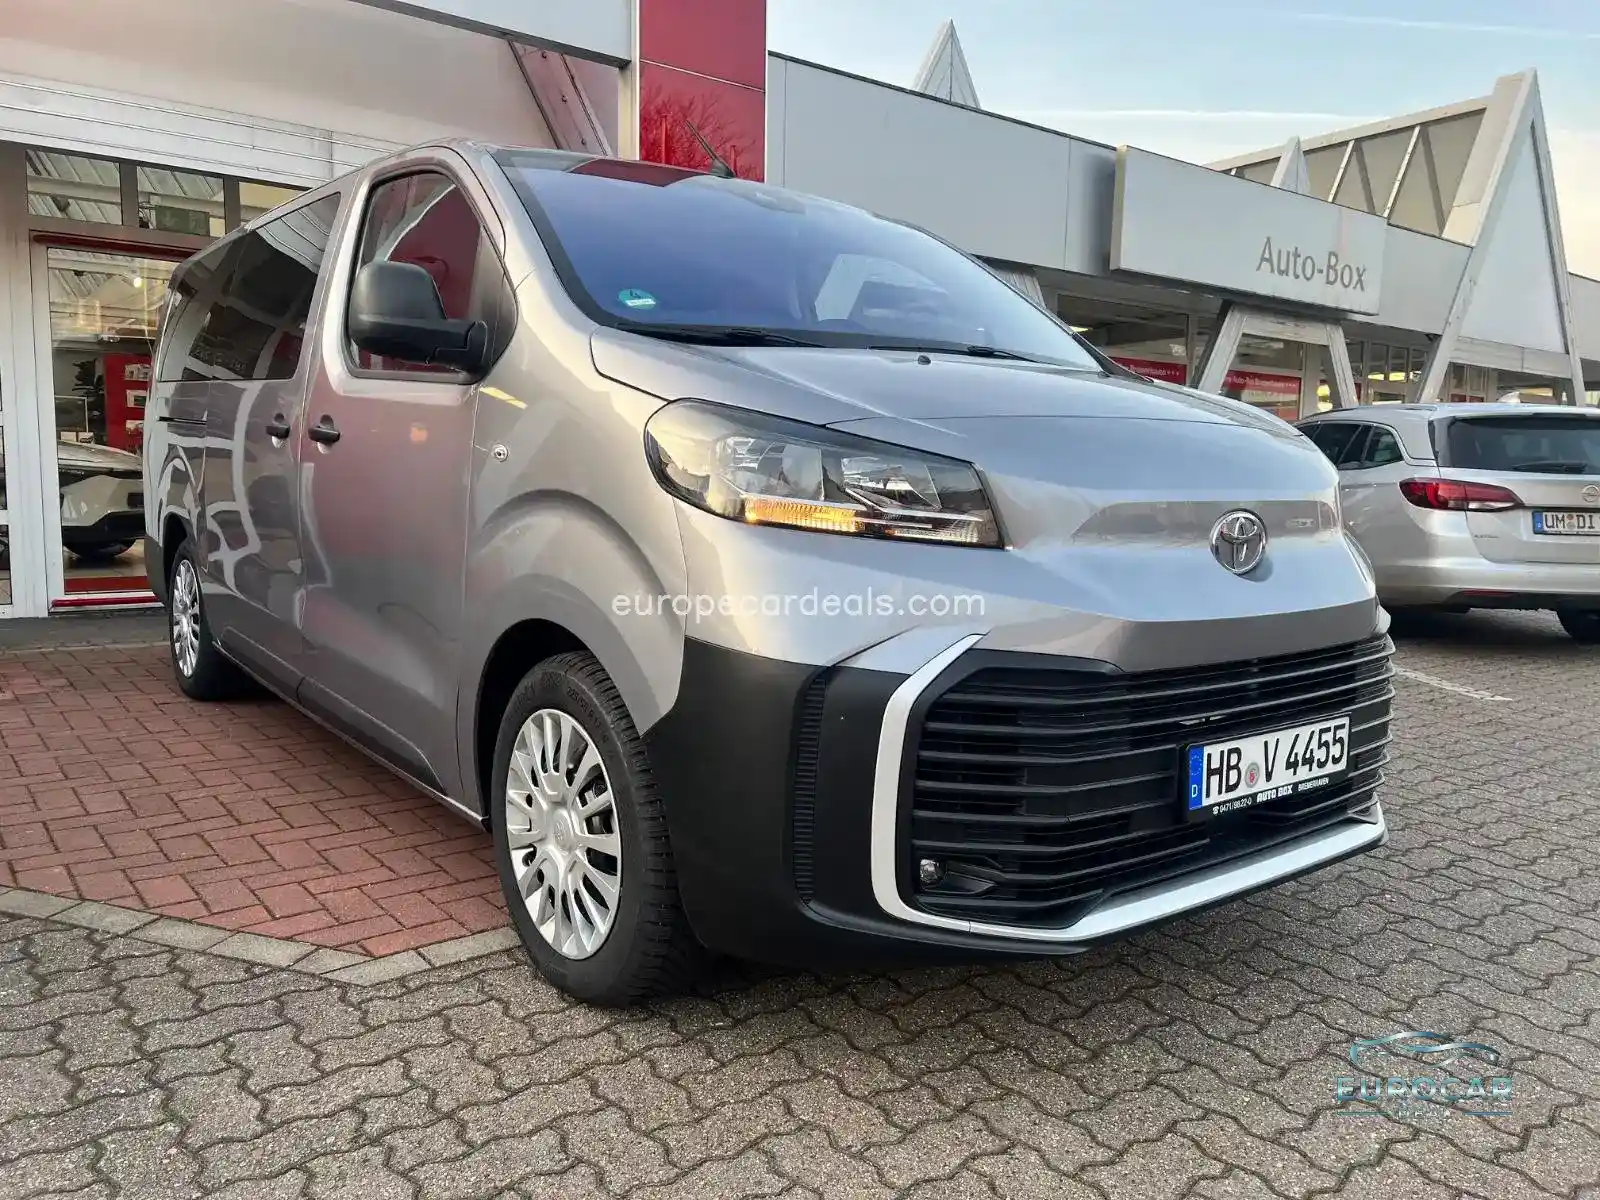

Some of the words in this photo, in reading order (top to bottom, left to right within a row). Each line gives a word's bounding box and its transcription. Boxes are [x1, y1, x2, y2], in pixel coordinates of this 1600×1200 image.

[1256, 237, 1366, 292] Auto-Box
[1544, 514, 1566, 529] UM
[1576, 514, 1596, 529] DI
[1191, 784, 1199, 798] D
[1205, 747, 1242, 799] HB
[1263, 737, 1280, 783] V
[1285, 722, 1347, 776] 4455
[1256, 789, 1276, 803] AUTO
[1277, 785, 1293, 797] BOX
